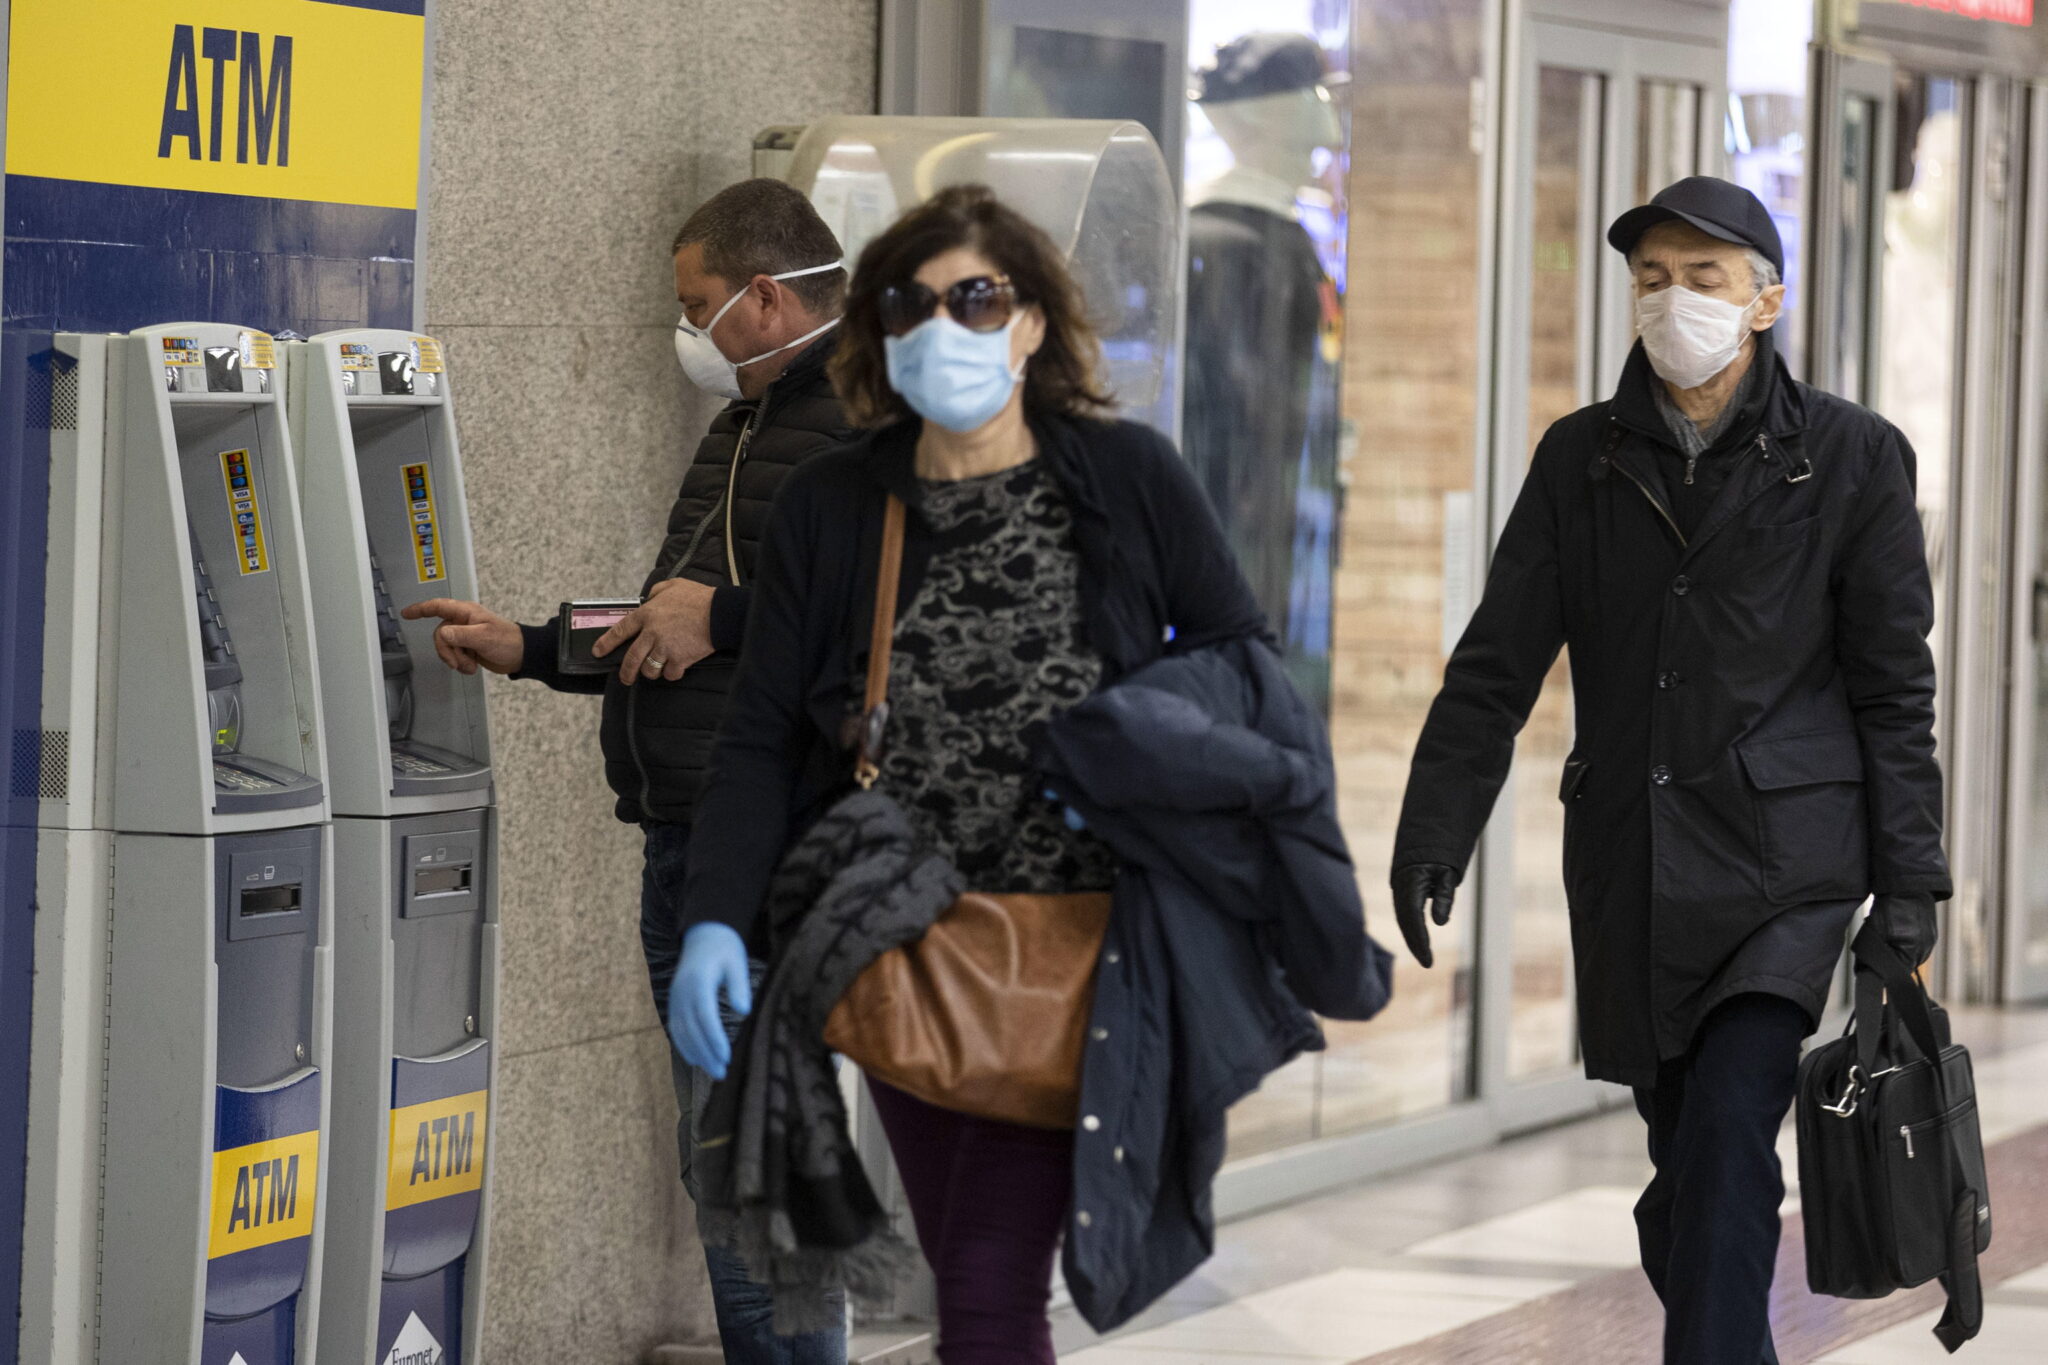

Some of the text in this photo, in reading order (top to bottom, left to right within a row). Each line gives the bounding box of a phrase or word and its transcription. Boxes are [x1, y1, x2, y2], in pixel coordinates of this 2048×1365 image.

[158, 24, 293, 167] ATM
[409, 1111, 475, 1186] ATM
[228, 1154, 299, 1234] ATM
